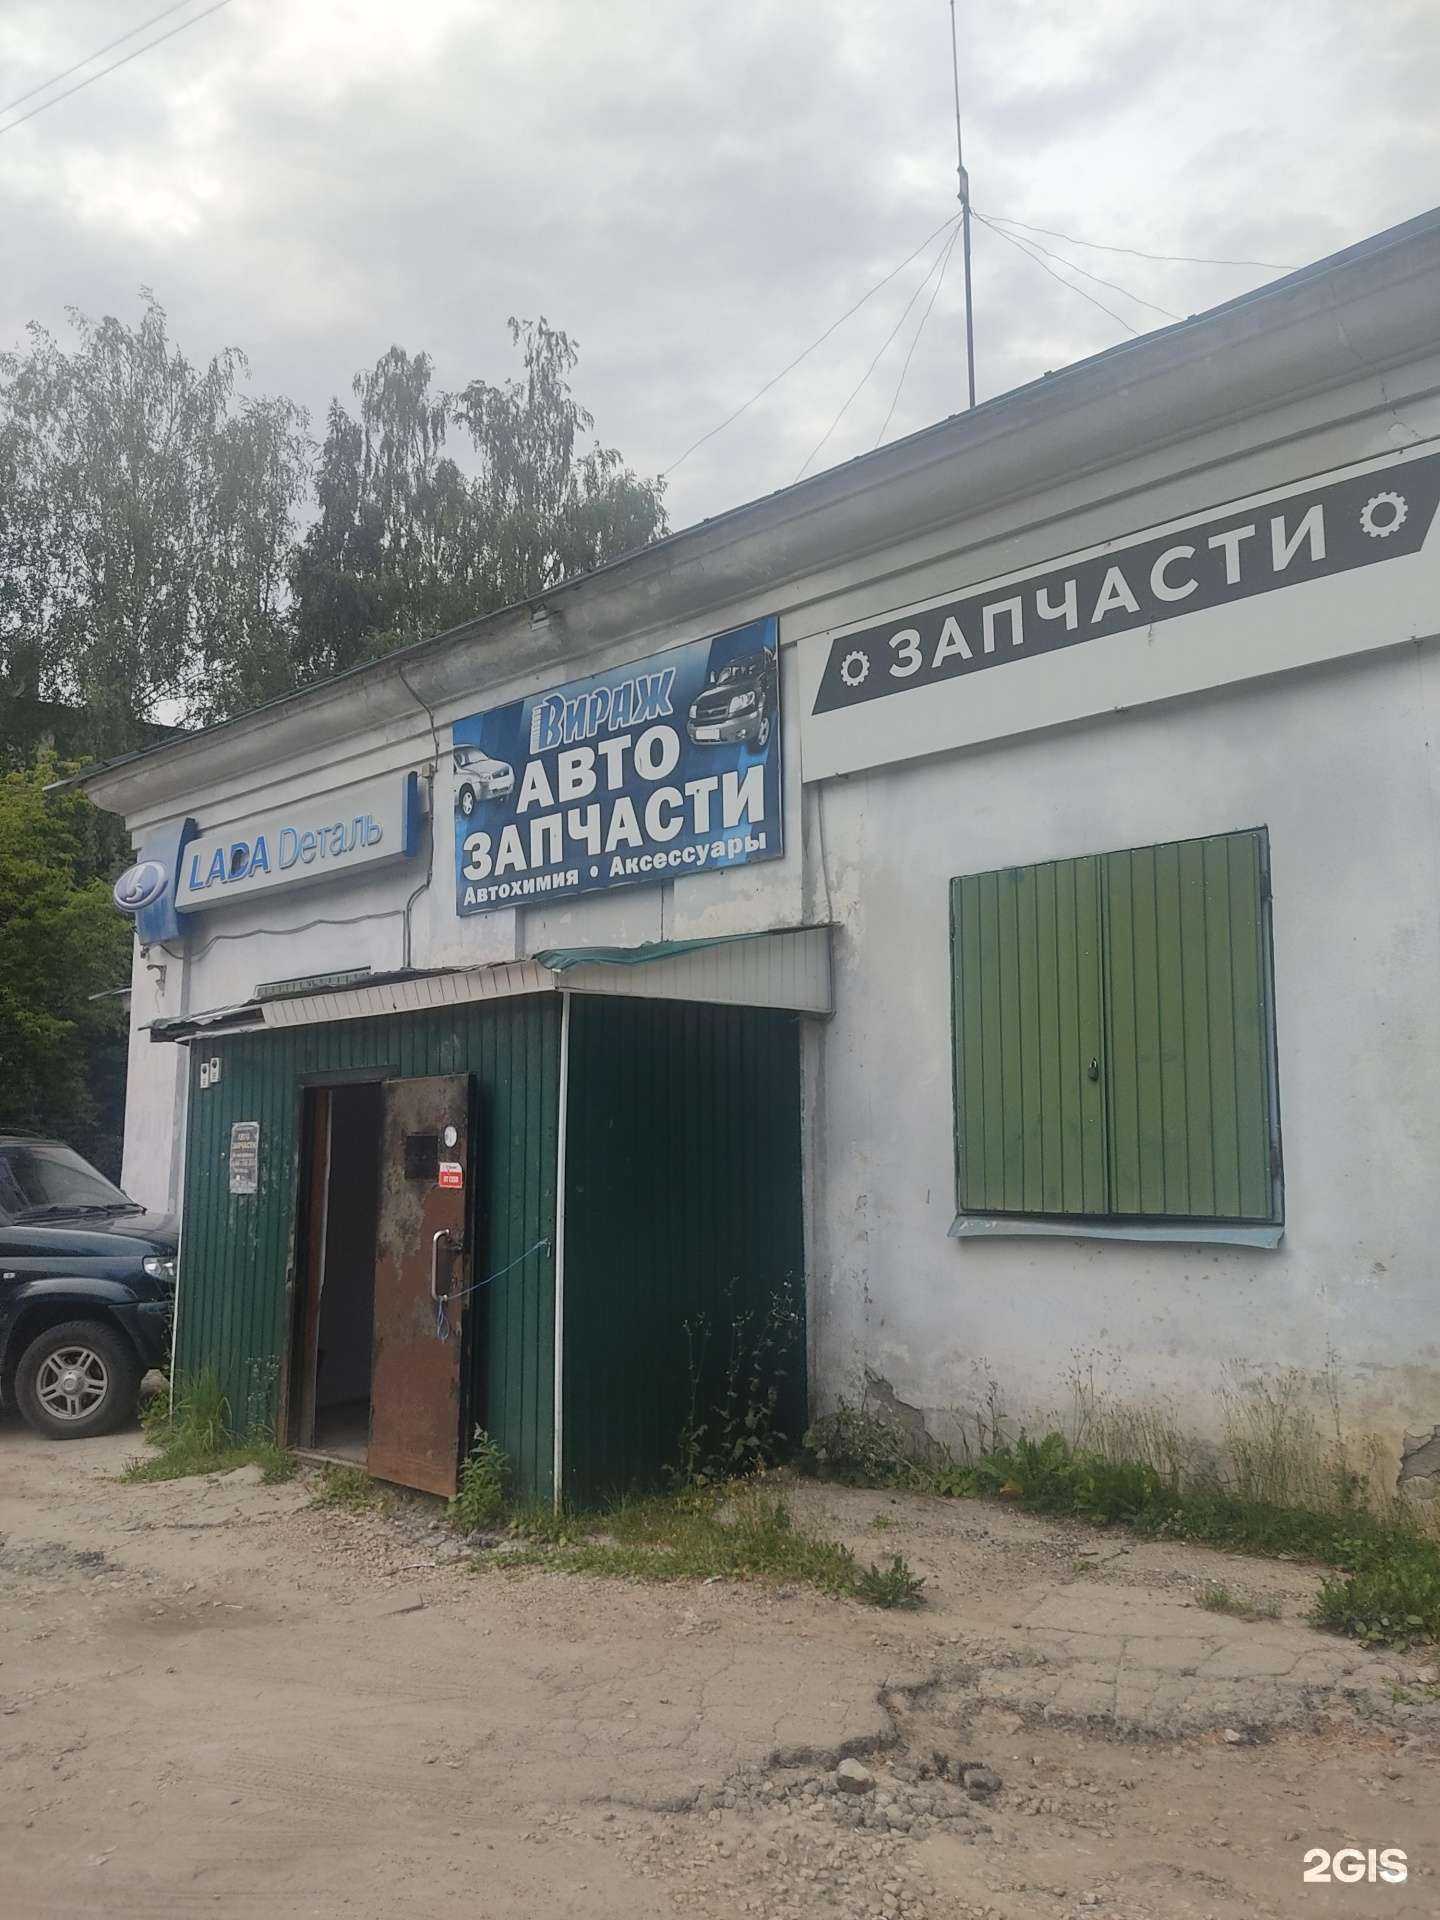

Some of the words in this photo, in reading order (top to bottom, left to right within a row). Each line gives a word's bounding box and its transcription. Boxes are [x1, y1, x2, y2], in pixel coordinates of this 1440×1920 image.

[887, 503, 1327, 678] ЗАПЧАСТИ
[515, 724, 681, 814] АВТО
[188, 835, 271, 891] LADA
[462, 764, 765, 882] ЗАПЧАСТИ
[463, 868, 580, 906] Автохимия
[609, 831, 767, 878] Аксессуары
